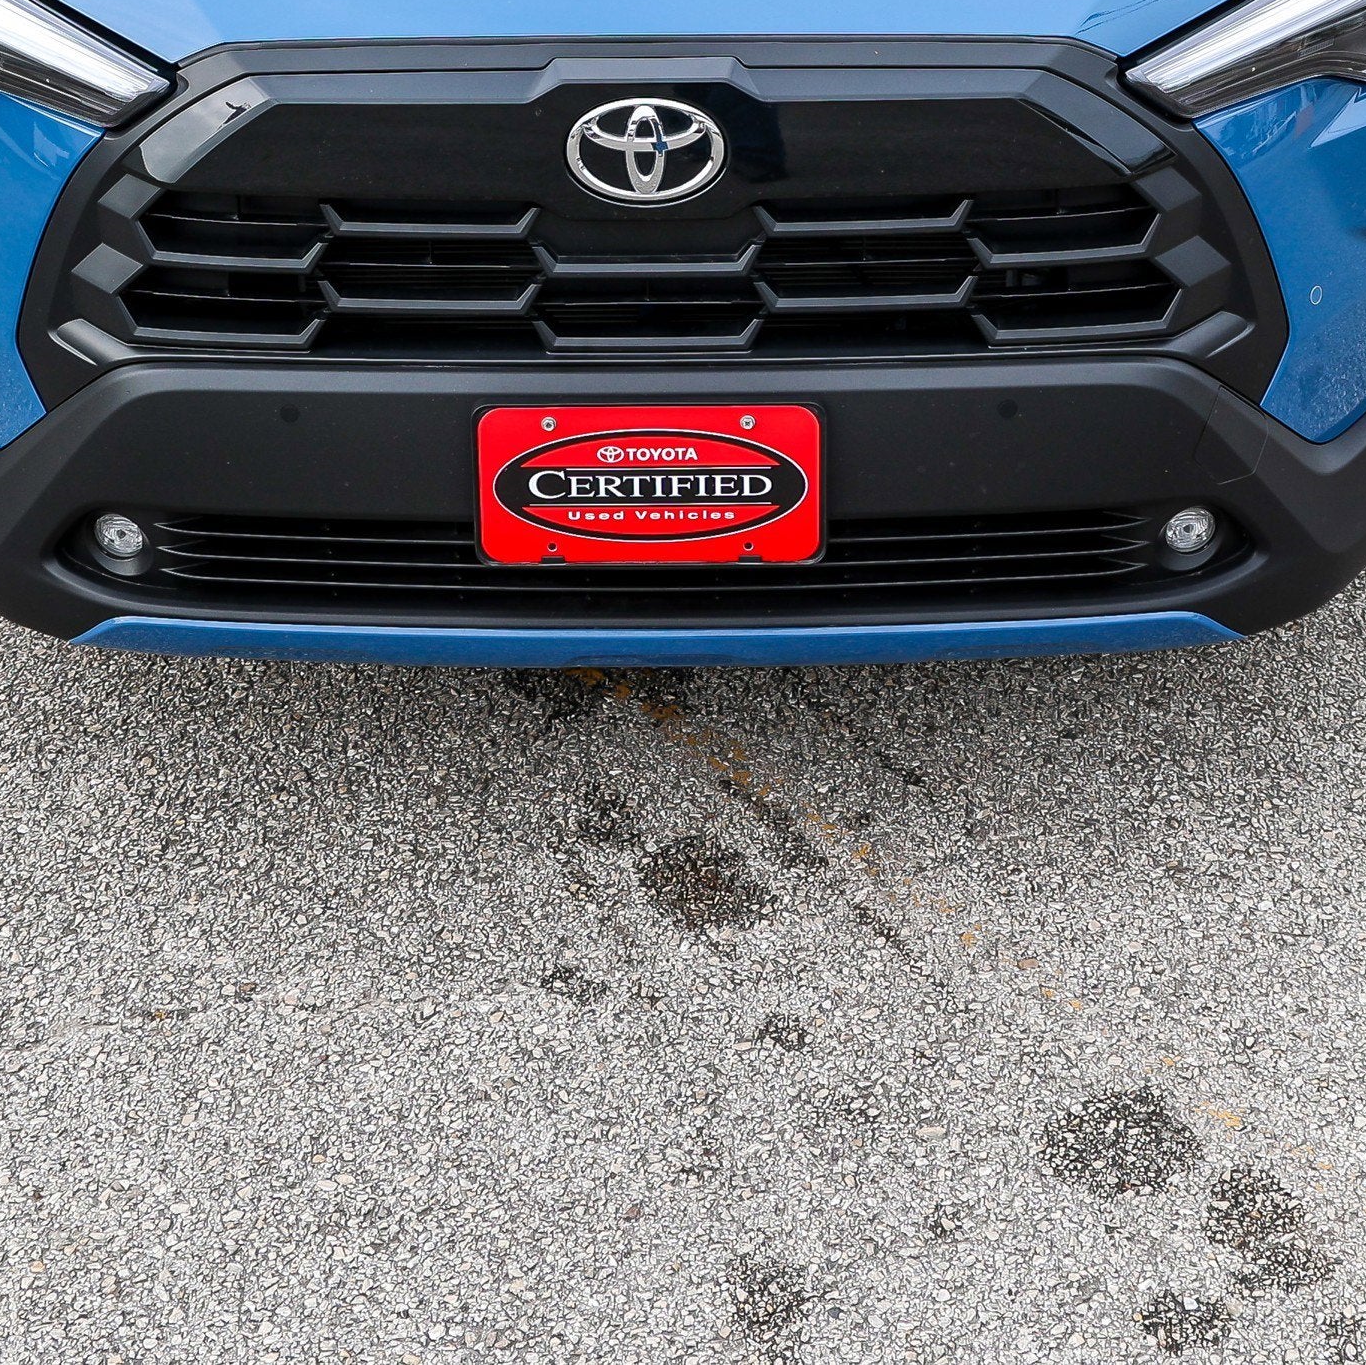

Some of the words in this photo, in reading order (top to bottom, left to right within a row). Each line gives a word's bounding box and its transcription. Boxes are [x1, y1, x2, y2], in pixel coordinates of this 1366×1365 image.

[626, 447, 698, 461] TOYOTA
[528, 470, 772, 499] CERTIFIED
[568, 510, 624, 521] Used
[635, 510, 735, 521] Vehicles
